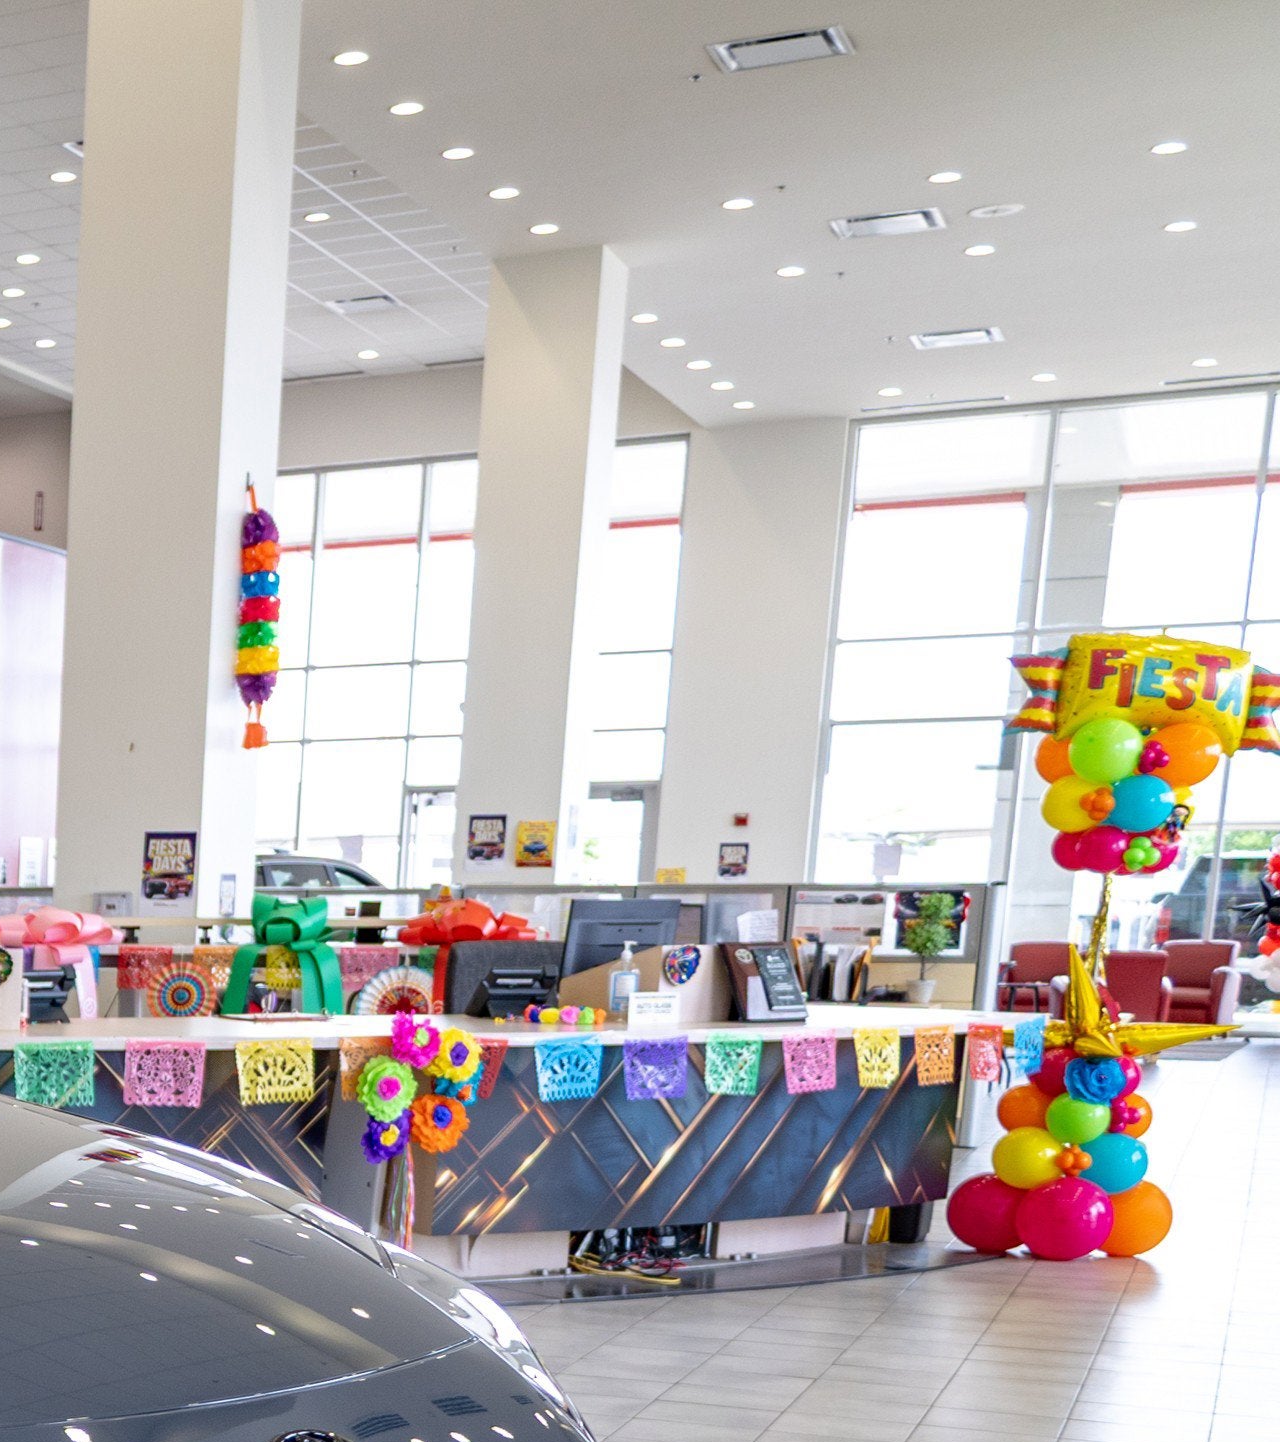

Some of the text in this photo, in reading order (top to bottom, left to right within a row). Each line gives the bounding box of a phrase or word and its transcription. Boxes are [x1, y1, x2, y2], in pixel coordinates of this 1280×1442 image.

[1087, 648, 1243, 717] FIESTA
[148, 839, 192, 857] FIESTA
[153, 856, 186, 873] DAYS
